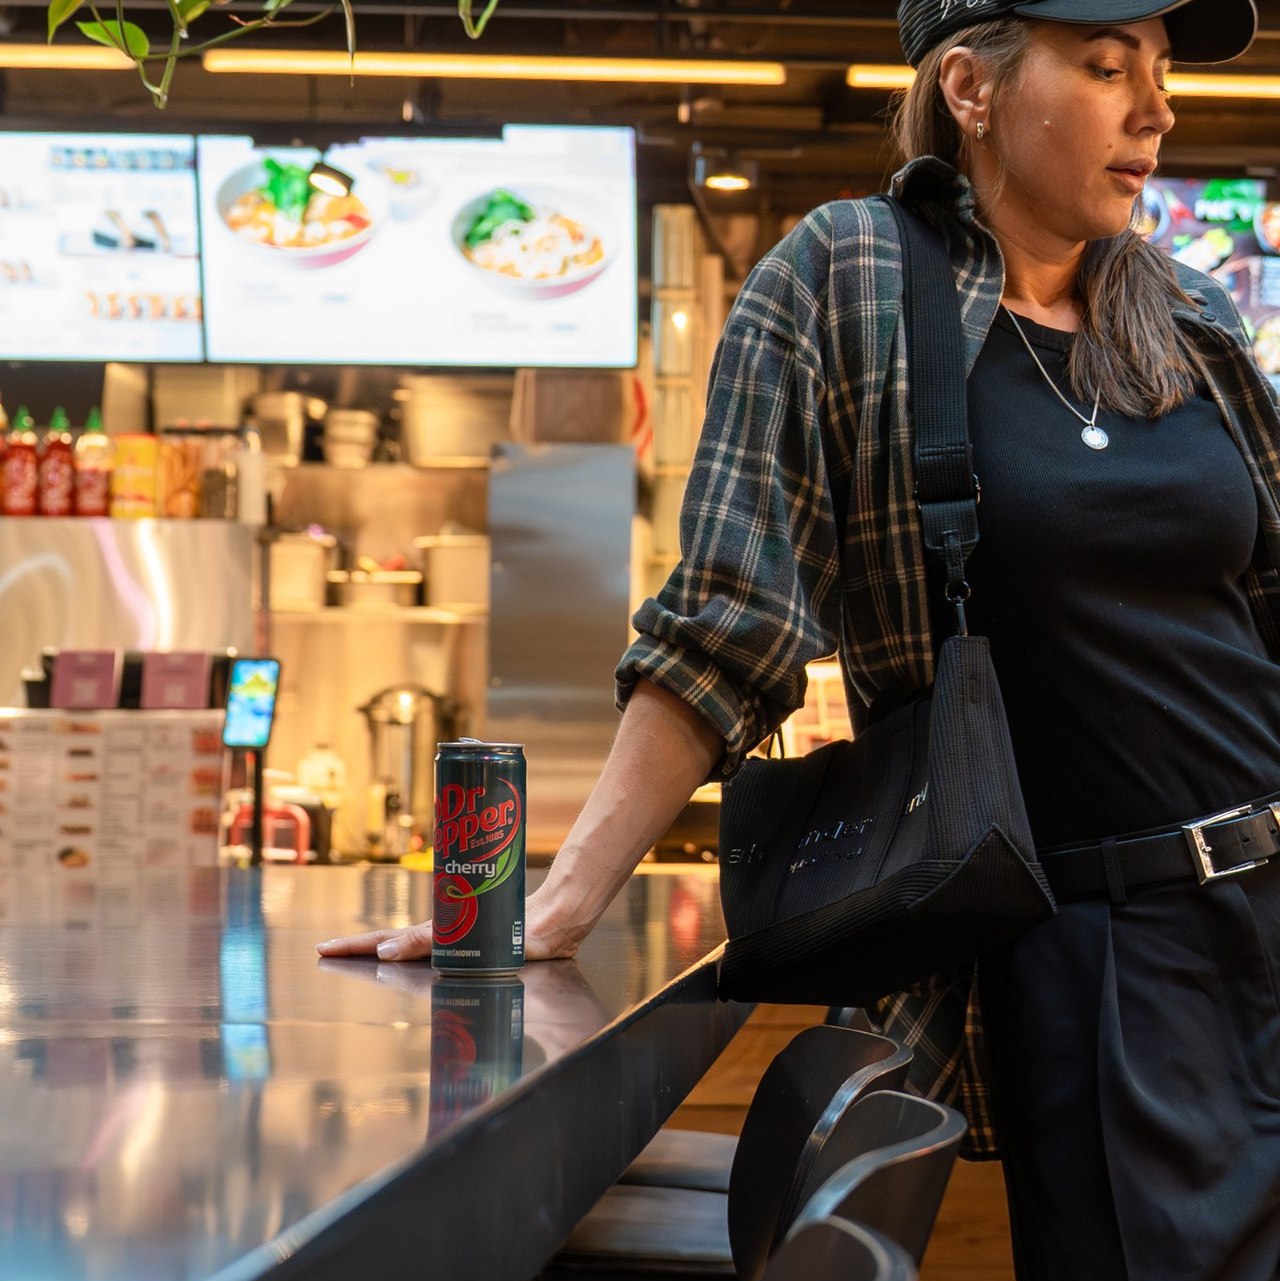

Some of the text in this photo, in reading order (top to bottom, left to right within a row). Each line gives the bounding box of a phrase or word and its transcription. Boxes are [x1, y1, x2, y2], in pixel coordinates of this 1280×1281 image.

[442, 783, 486, 823] Dr
[434, 798, 515, 860] epper
[445, 860, 496, 878] cherry
